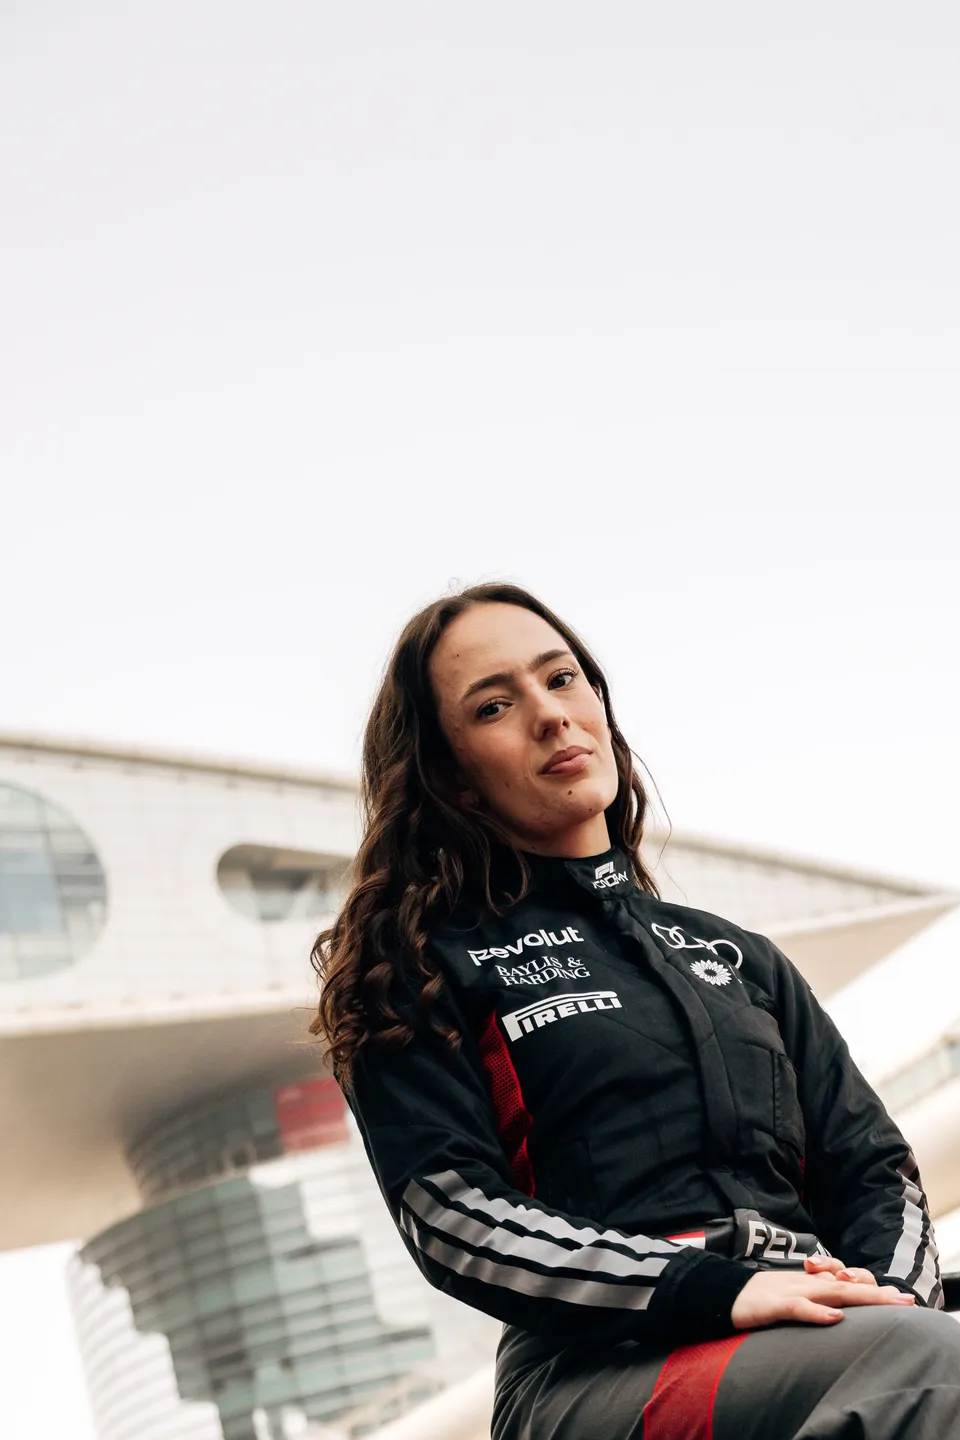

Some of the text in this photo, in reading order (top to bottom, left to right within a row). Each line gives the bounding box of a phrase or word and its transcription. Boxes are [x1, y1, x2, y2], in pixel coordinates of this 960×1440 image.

[595, 861, 615, 880] F1
[495, 956, 585, 977] BAYLIS &
[501, 967, 591, 986] HARDING
[501, 991, 622, 1042] PIRELLI
